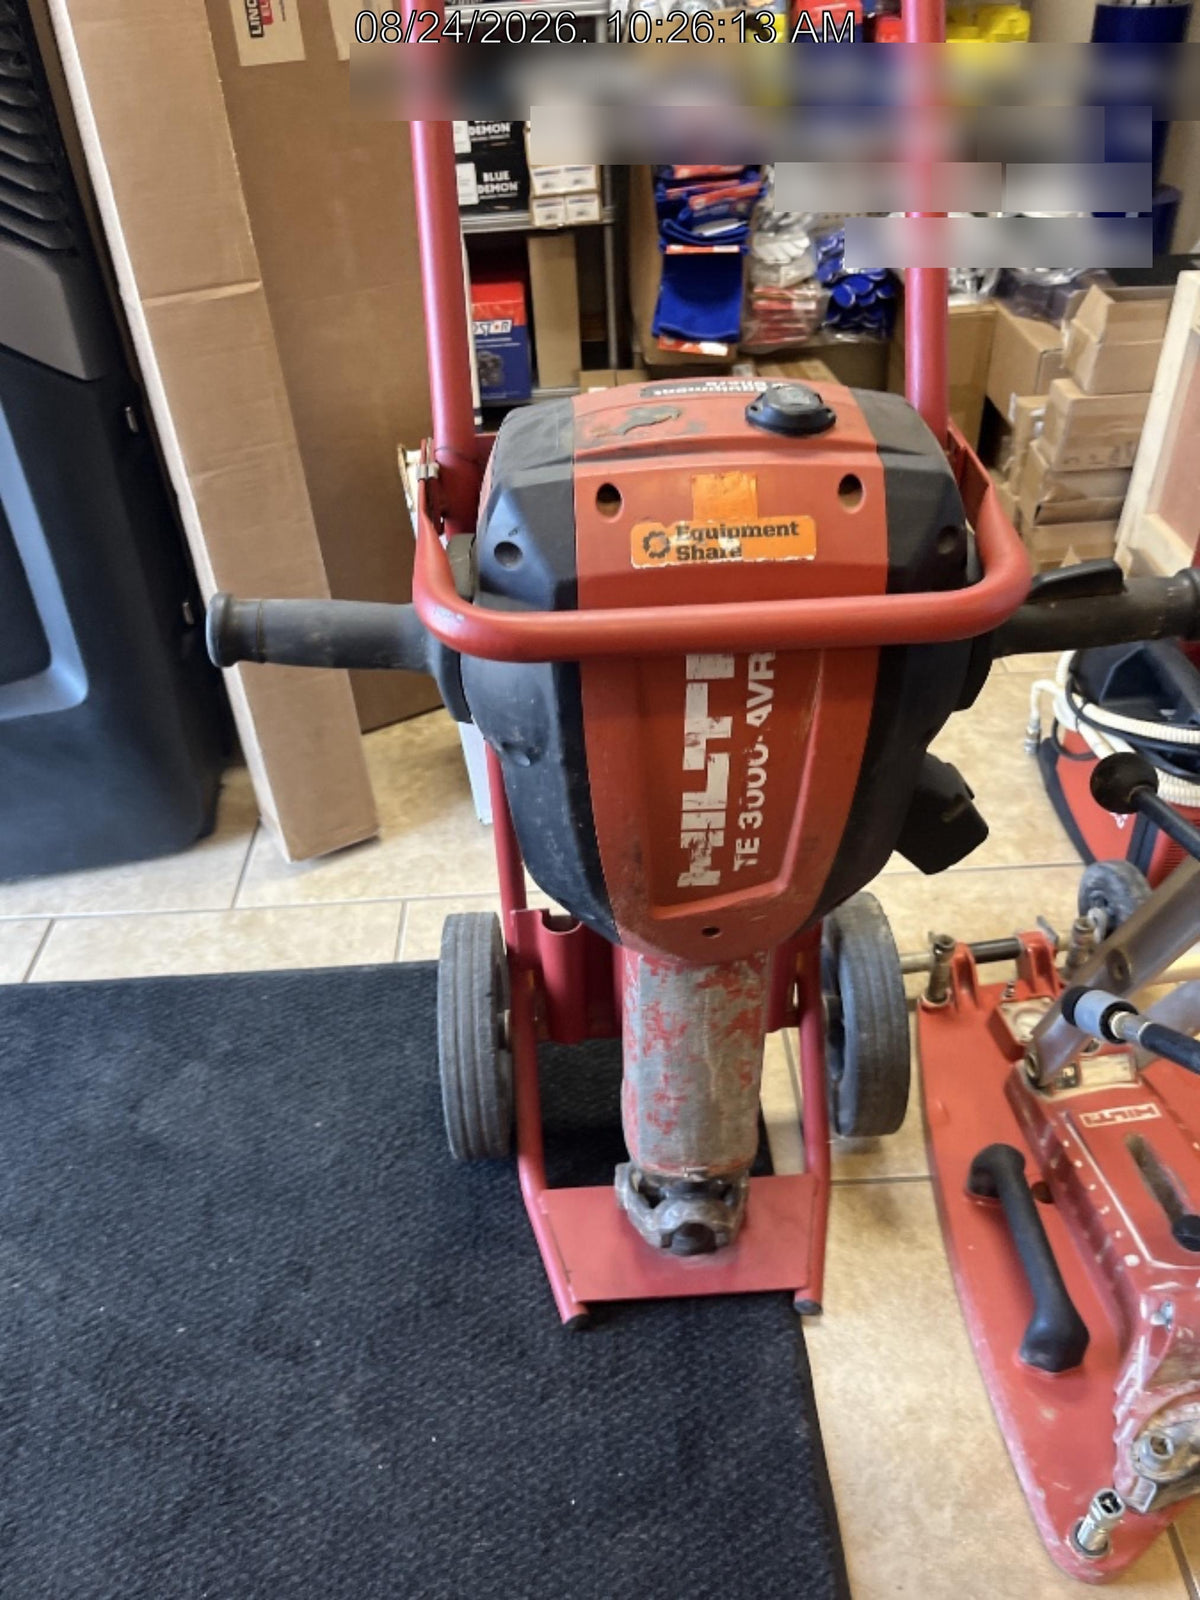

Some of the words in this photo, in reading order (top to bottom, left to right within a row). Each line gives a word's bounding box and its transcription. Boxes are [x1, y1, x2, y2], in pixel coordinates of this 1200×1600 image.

[468, 122, 511, 137] DEMON
[483, 170, 510, 182] BLUE
[477, 181, 519, 195] DEMON
[675, 522, 799, 542] Equipment
[676, 544, 742, 561] Share
[677, 653, 735, 888] HILTI
[733, 837, 760, 872] TE
